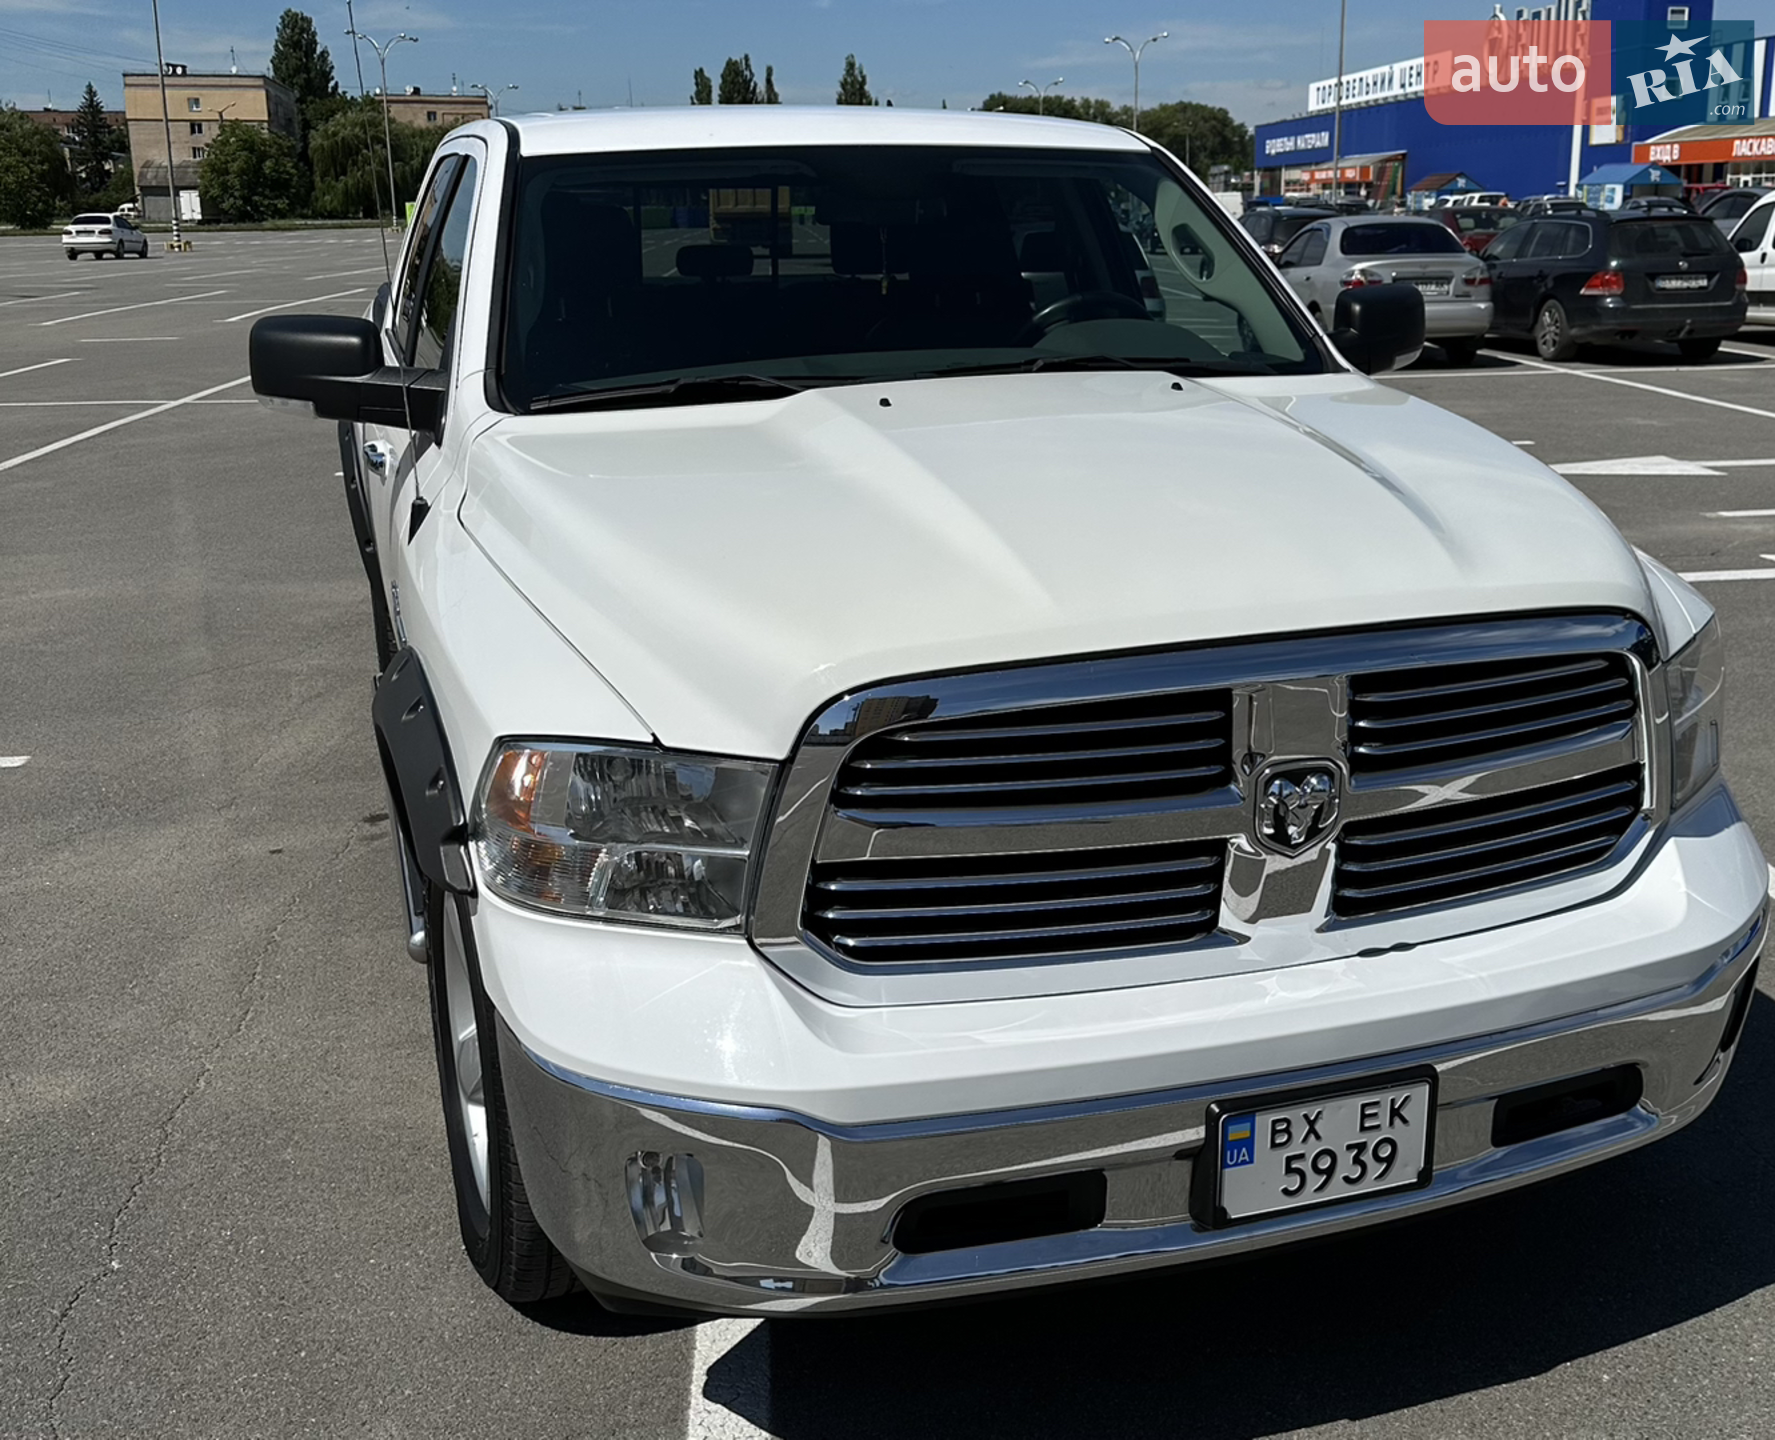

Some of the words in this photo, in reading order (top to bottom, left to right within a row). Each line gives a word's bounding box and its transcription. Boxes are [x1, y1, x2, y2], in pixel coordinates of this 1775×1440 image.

[1399, 60, 1439, 92] ЦЕНТР
[1731, 137, 1775, 157] ЛАСКАВ
[1269, 1109, 1323, 1149] BX
[1358, 1094, 1411, 1132] EK
[1226, 1147, 1250, 1165] UA
[1279, 1136, 1398, 1197] 5939
